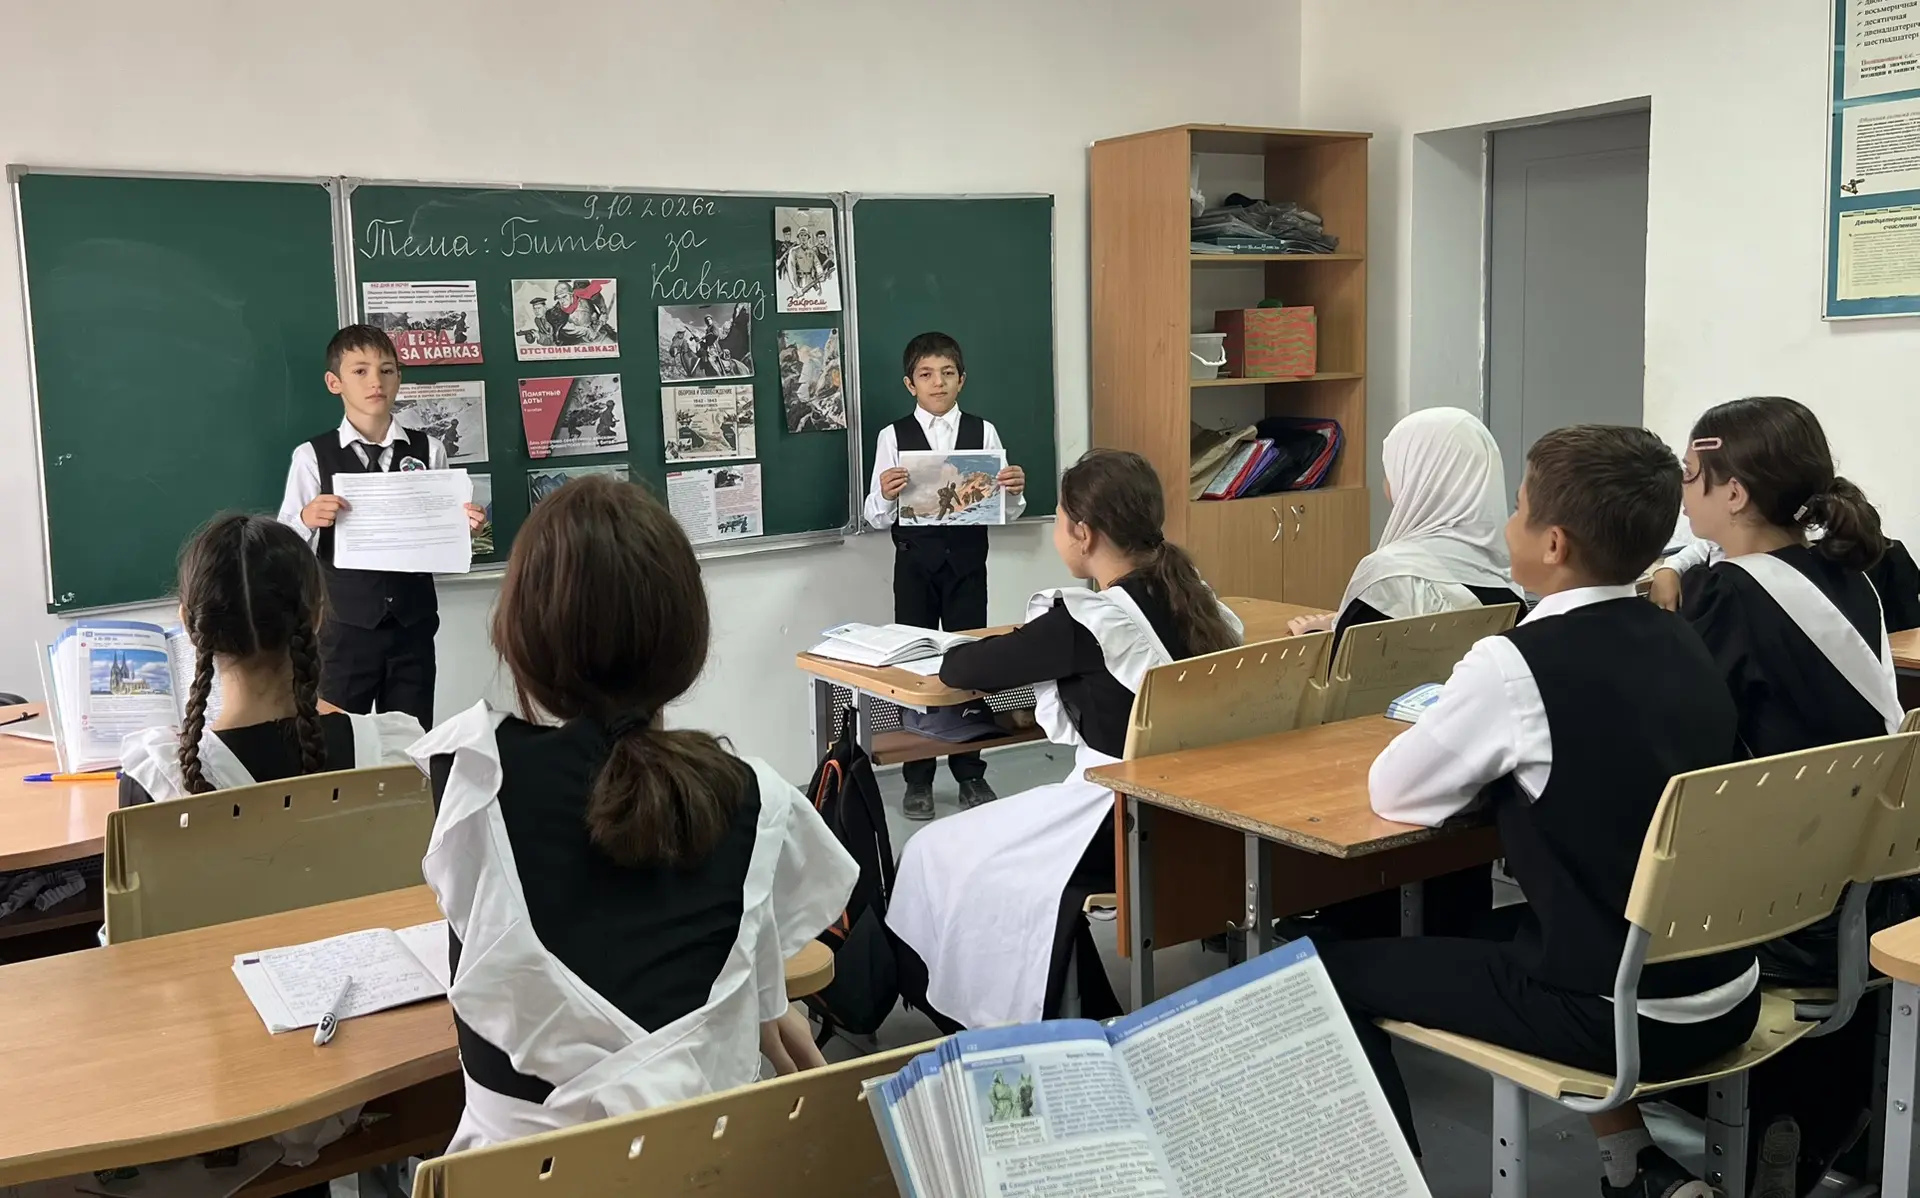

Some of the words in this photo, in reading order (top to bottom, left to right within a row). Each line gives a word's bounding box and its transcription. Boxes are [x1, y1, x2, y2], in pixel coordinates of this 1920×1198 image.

[1864, 1, 1917, 15] восьмеричная
[1864, 13, 1907, 27] десятичная
[501, 216, 636, 257] Битва
[664, 230, 707, 273] за
[786, 296, 827, 307] Закроем
[400, 348, 420, 360] ЗА
[423, 345, 480, 360] КАВКАЗ
[520, 347, 571, 355] ОТСТОИМ
[574, 344, 617, 353] КАВКАЗ!
[522, 390, 561, 398] Памятные
